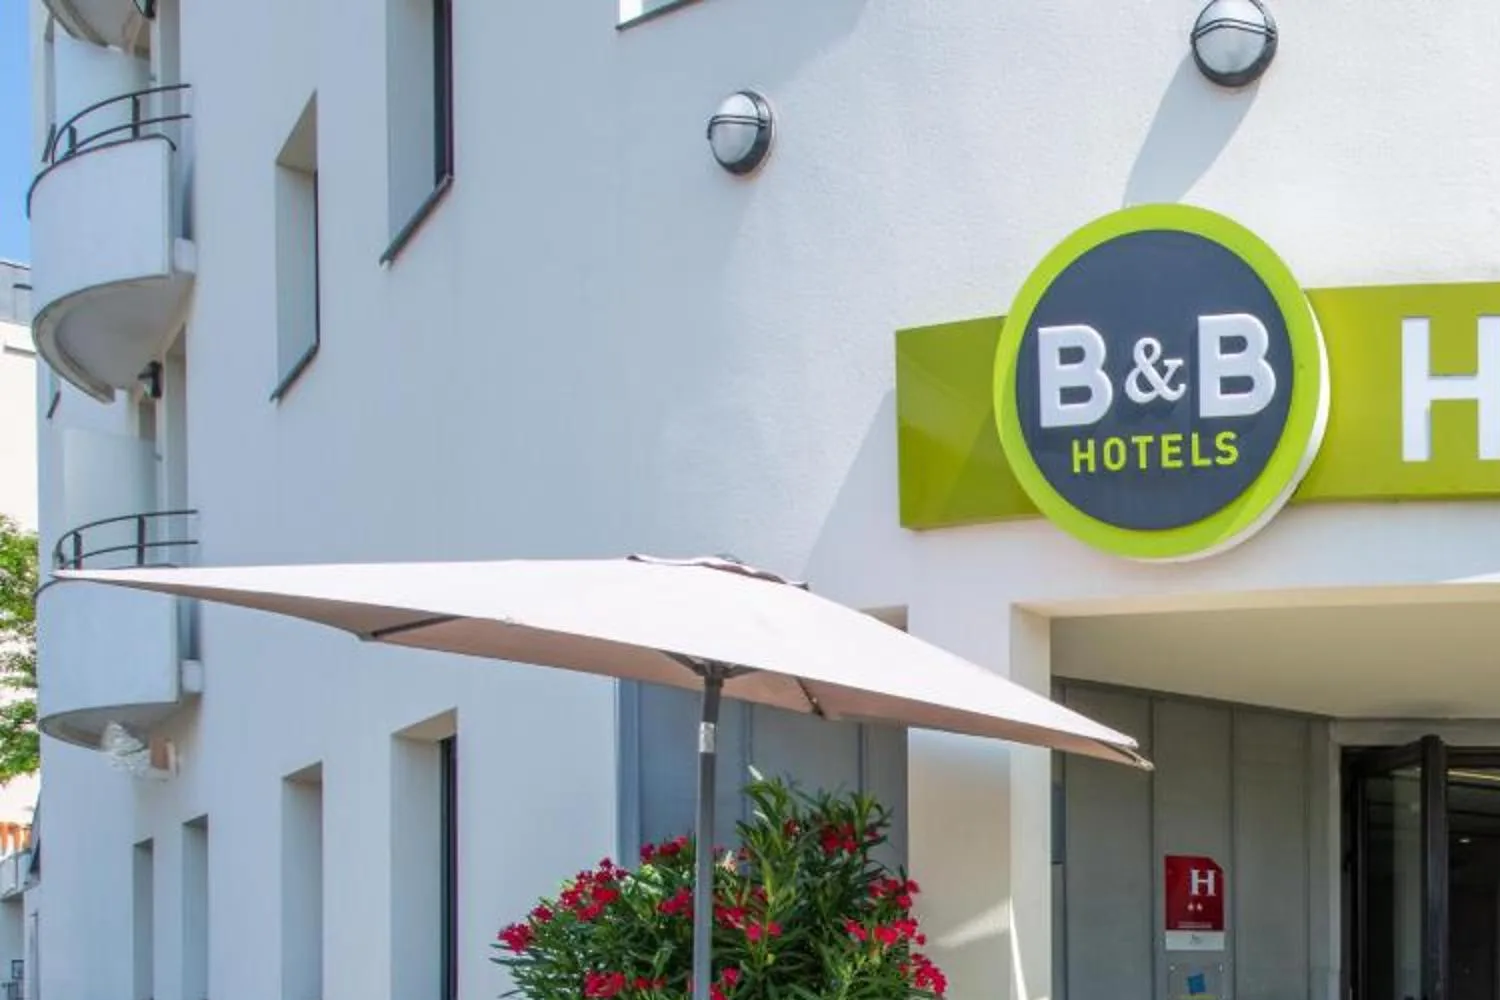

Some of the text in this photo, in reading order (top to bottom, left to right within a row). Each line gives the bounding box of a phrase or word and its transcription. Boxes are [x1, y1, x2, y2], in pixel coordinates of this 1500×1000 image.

[1037, 312, 1277, 429] B&B
[1072, 430, 1239, 473] HOTELS
[1190, 869, 1216, 896] H
